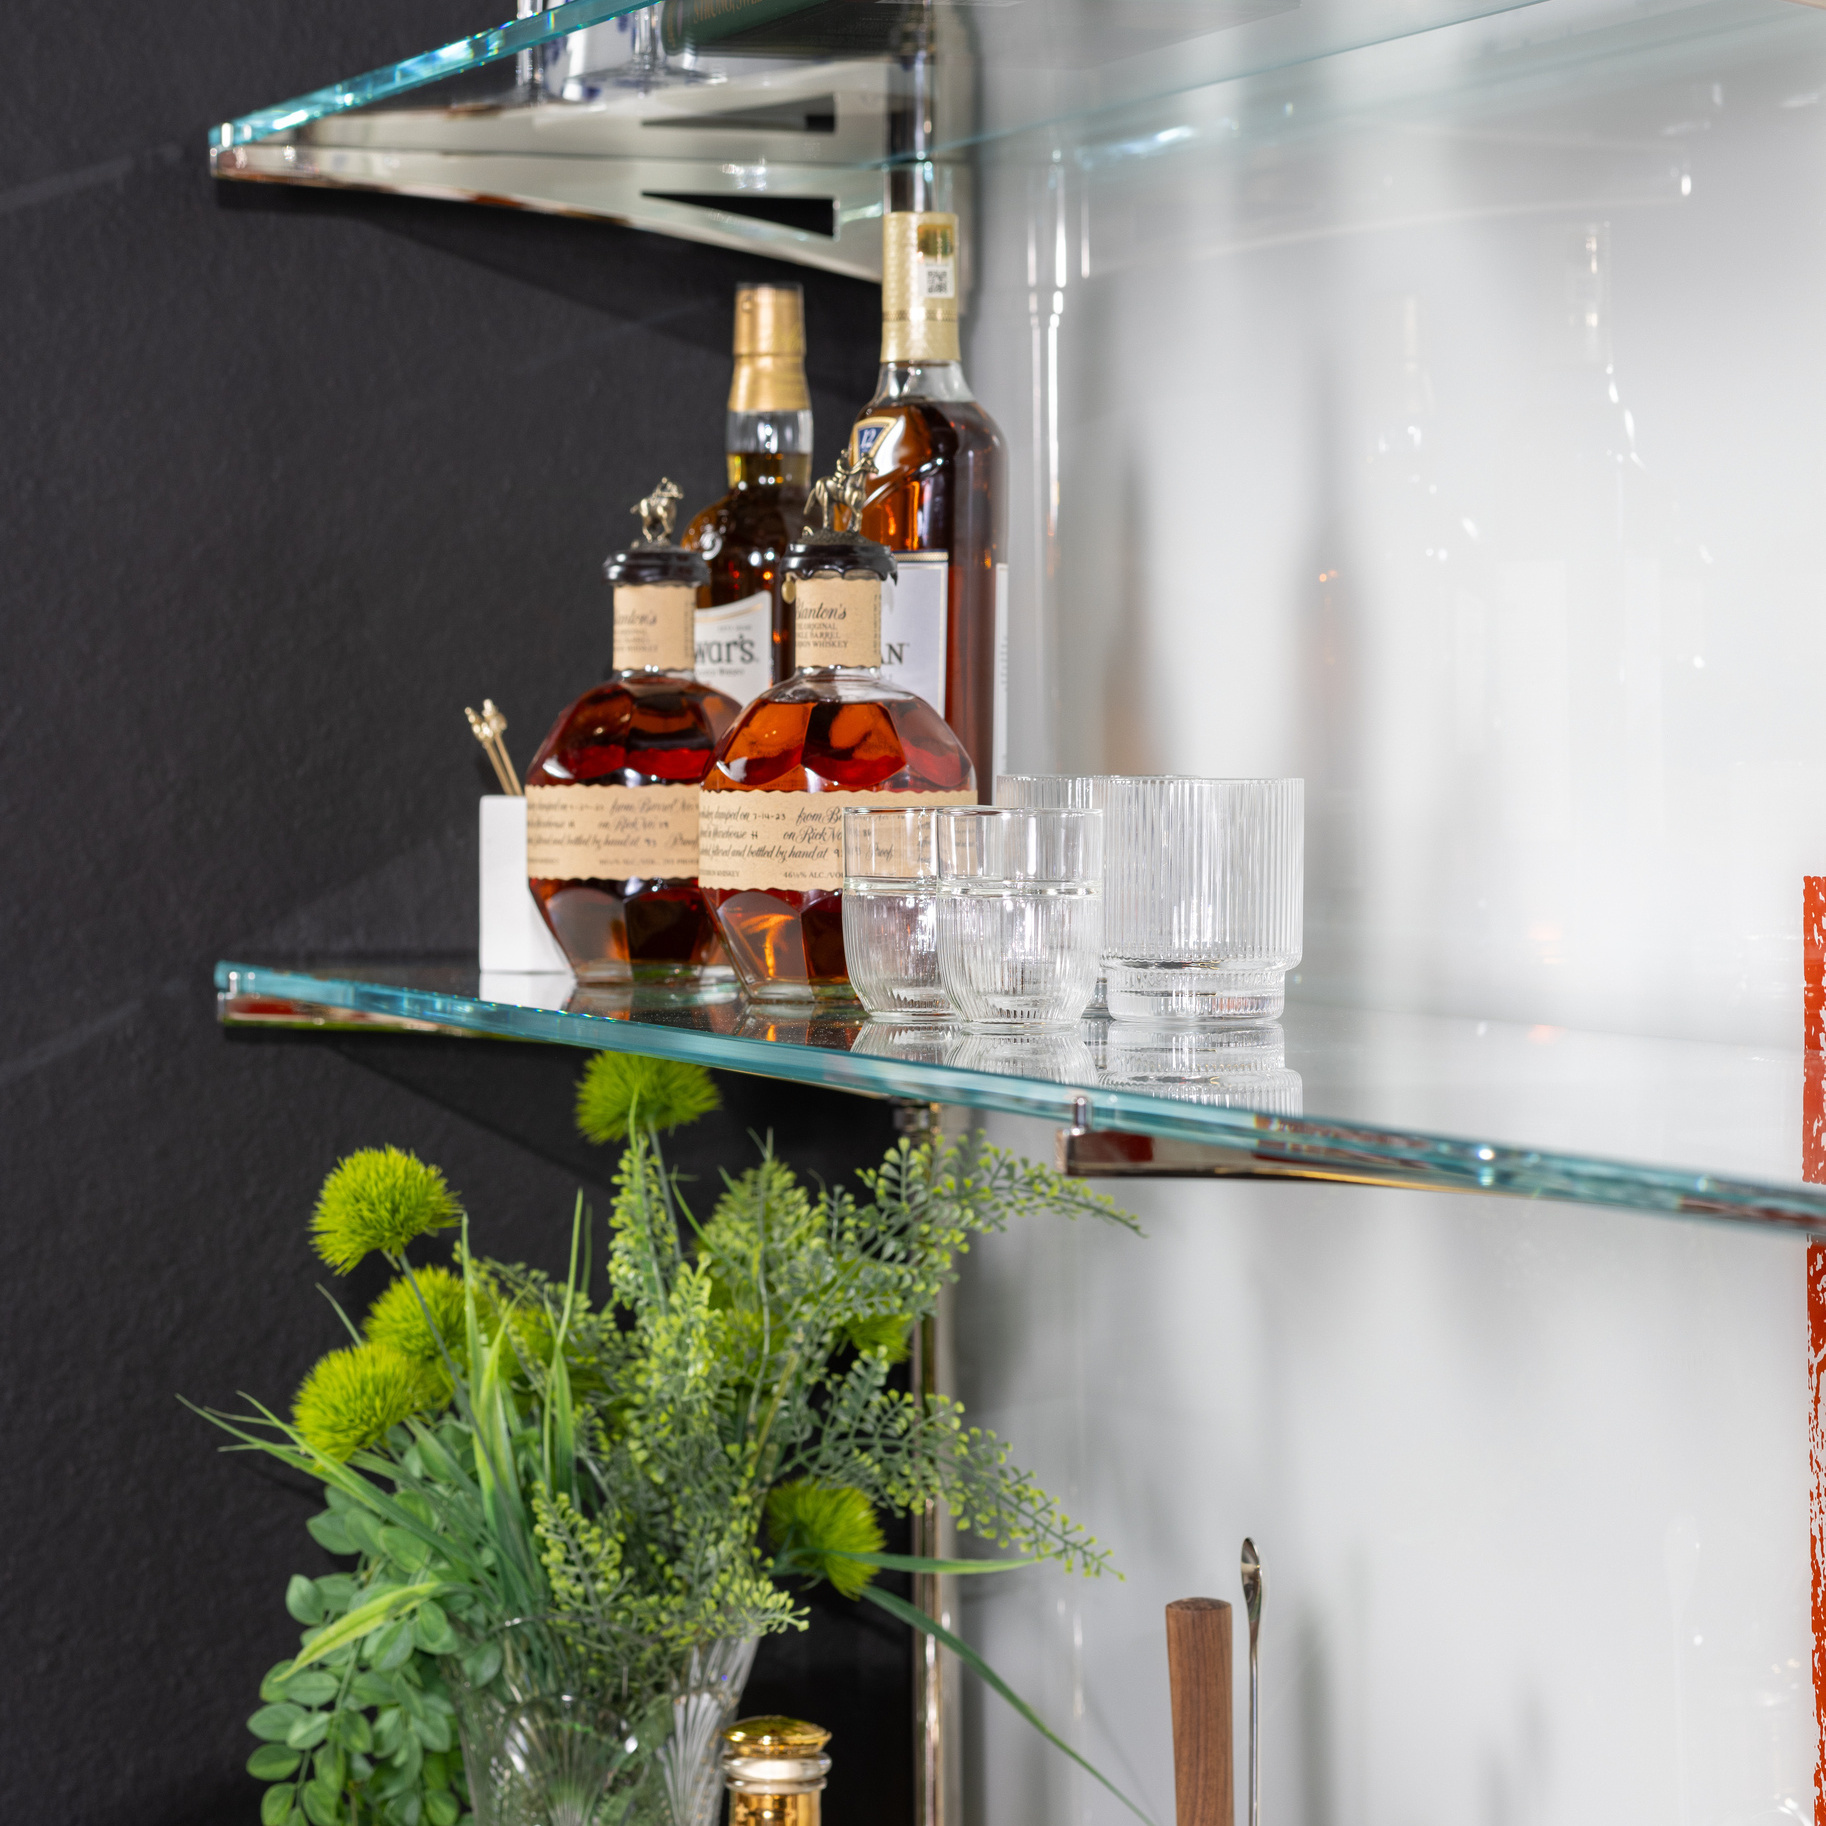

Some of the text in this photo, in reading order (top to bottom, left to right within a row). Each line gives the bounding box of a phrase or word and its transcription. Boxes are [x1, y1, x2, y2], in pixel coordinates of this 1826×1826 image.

[860, 428, 877, 448] 12
[796, 806, 822, 826] from
[783, 831, 796, 840] on
[796, 826, 827, 844] Rick
[747, 844, 776, 858] bottled
[776, 845, 788, 864] by
[788, 845, 817, 859] hand
[815, 847, 829, 859] at
